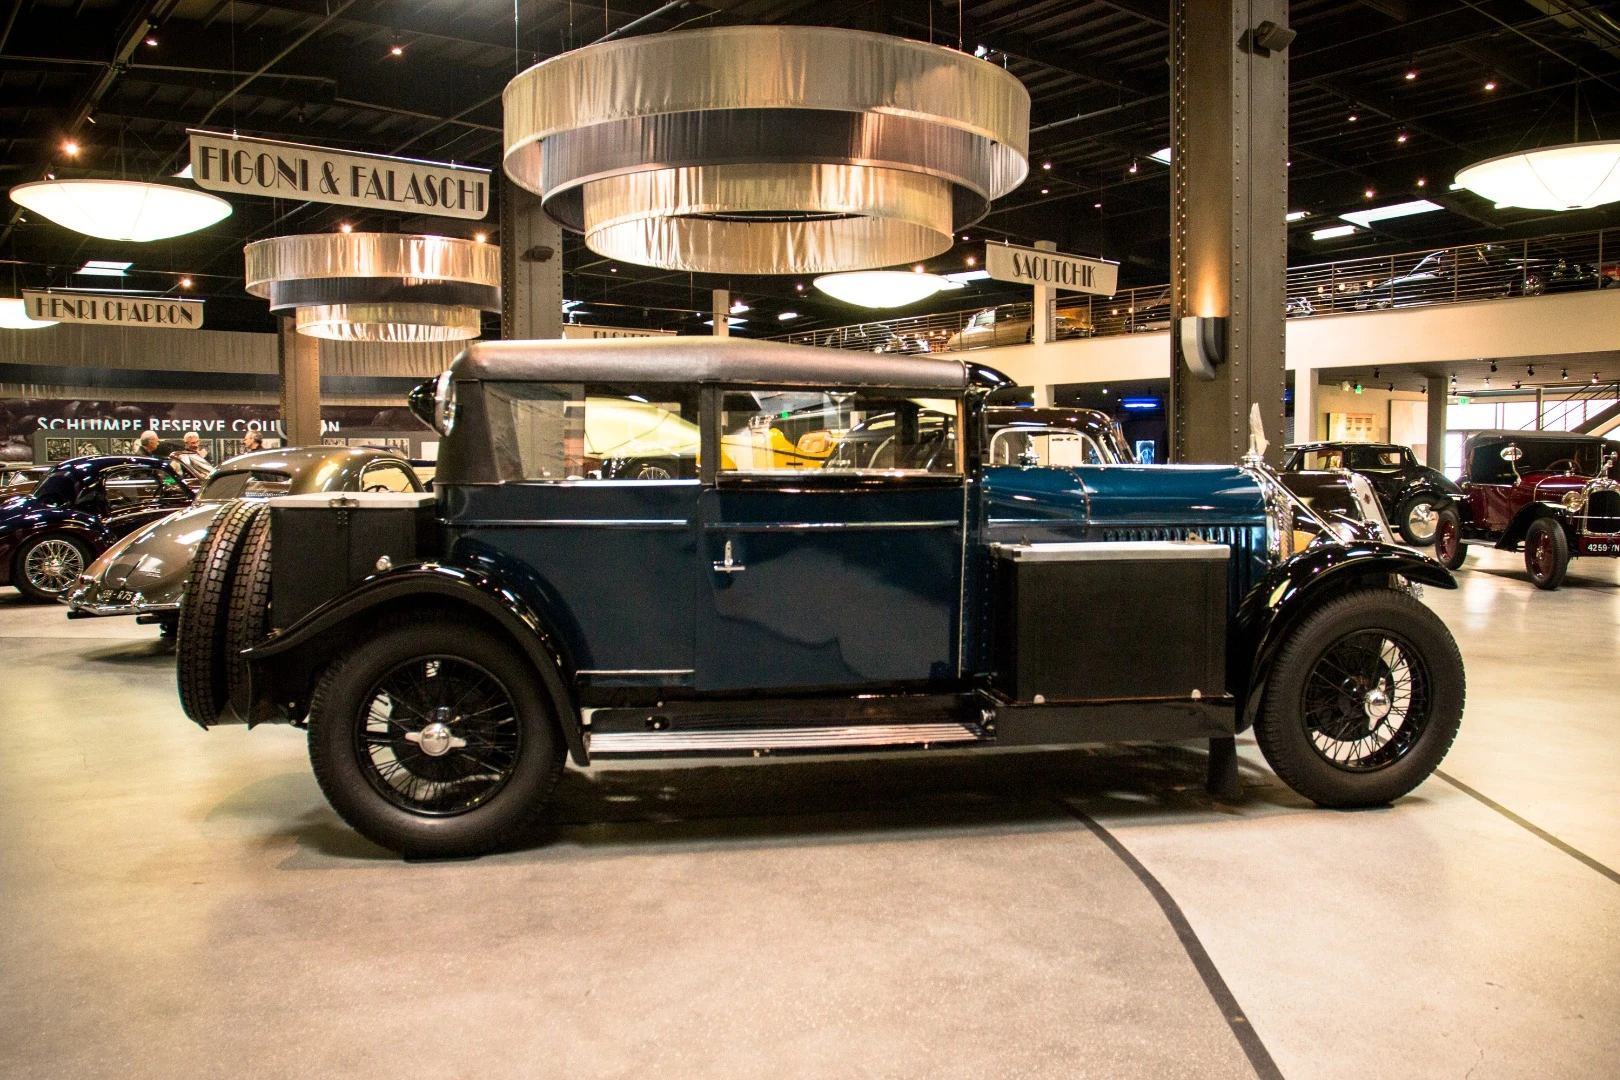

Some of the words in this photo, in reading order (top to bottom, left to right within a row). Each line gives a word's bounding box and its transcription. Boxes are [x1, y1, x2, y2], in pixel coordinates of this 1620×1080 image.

[200, 145, 309, 192] FIGONI
[319, 160, 340, 195] &
[351, 164, 484, 212] FALASCHI
[1012, 252, 1097, 289] SAOUTCHIK
[36, 297, 97, 320] HENRI
[103, 300, 193, 325] CHAPRON
[149, 418, 226, 431] RESERVE
